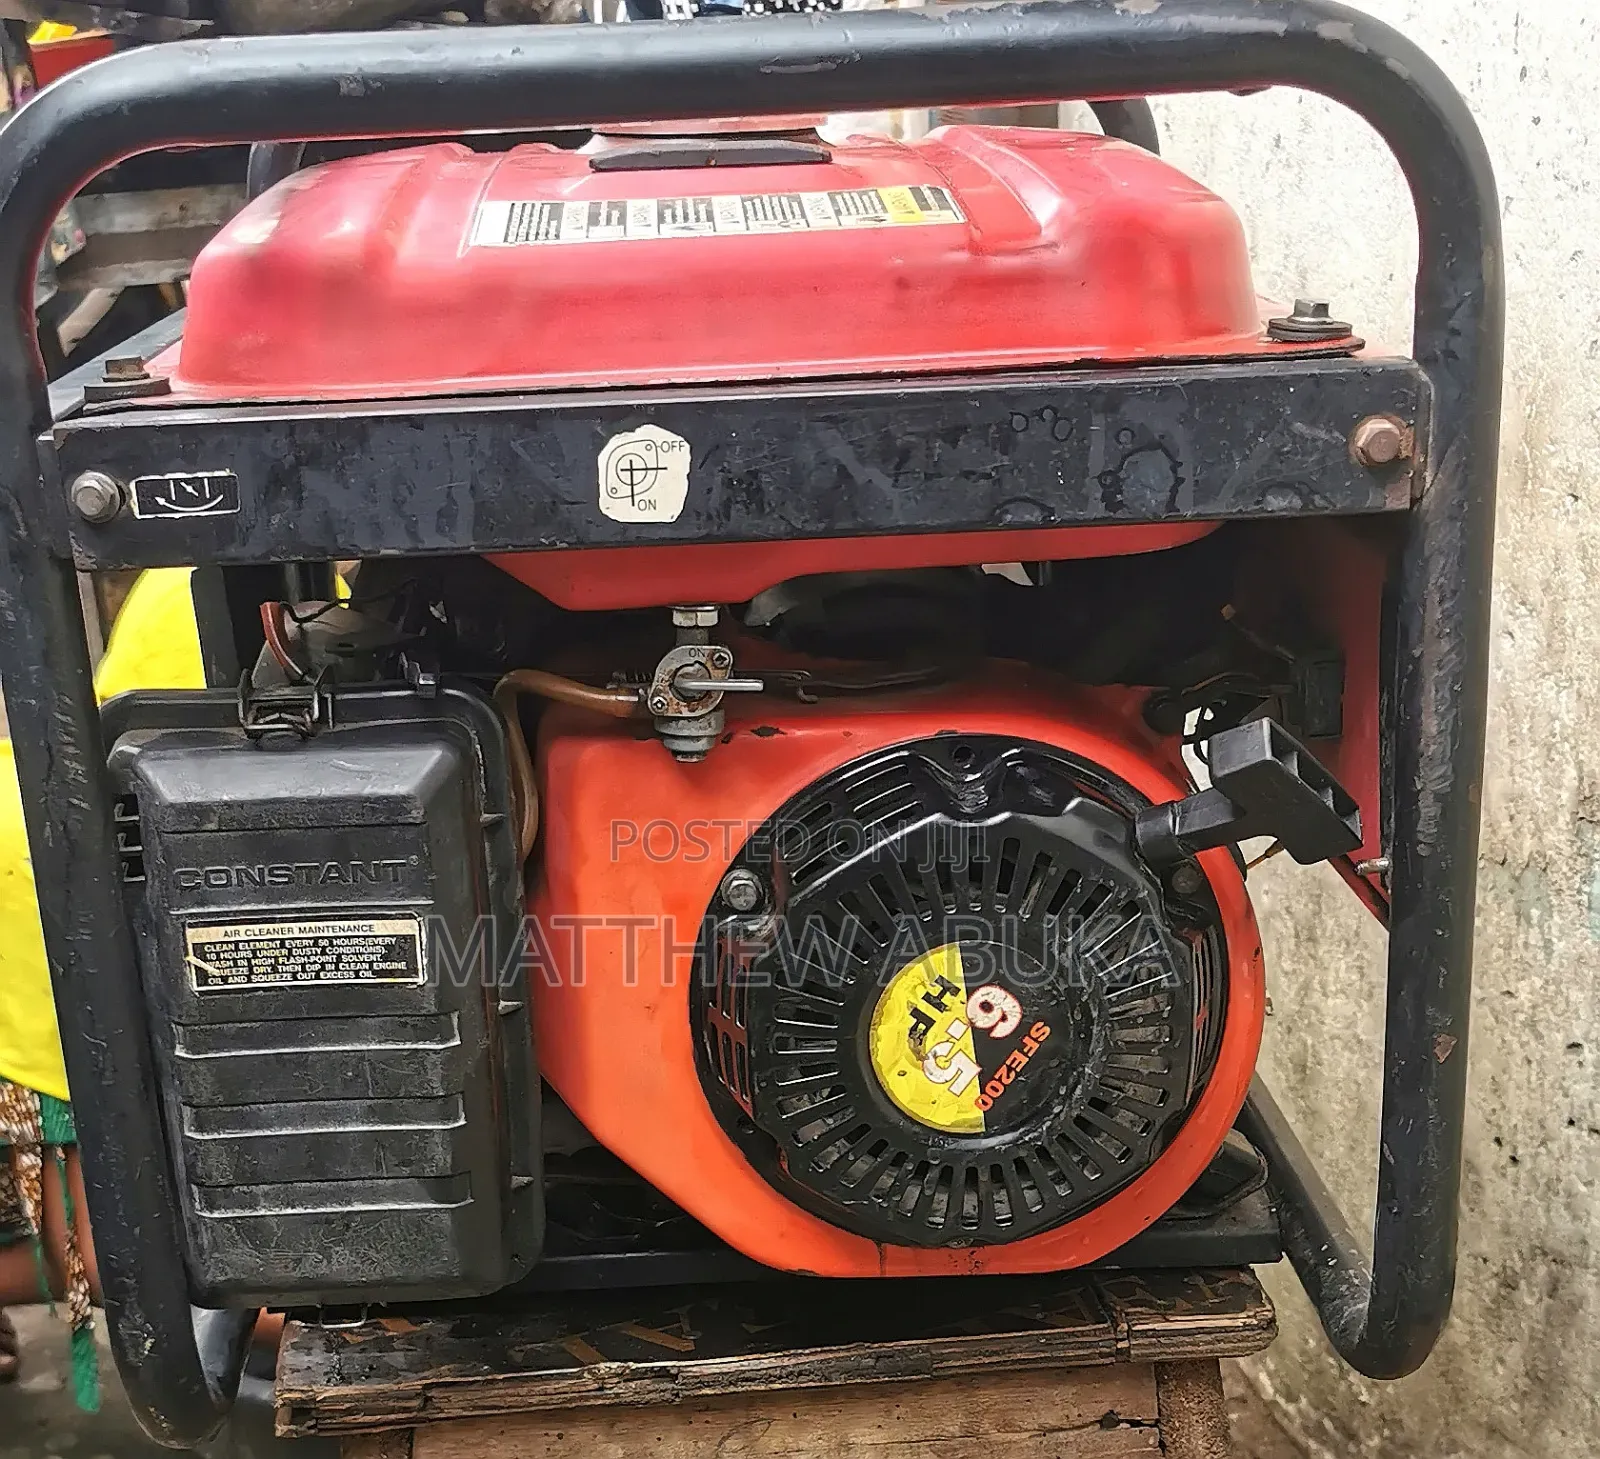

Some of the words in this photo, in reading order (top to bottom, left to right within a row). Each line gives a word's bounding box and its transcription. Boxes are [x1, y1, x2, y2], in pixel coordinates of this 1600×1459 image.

[660, 440, 686, 453] OFF
[637, 499, 657, 511] ON
[688, 647, 706, 657] ON
[223, 929, 241, 938] AIR
[244, 926, 294, 937] CLEANER
[298, 924, 376, 935] MAINTENANCE
[204, 943, 235, 952] CLEAN
[239, 940, 281, 950] ELEMENT
[285, 938, 314, 948] EVERY
[205, 952, 217, 961] 10
[220, 950, 253, 959] HOURS
[256, 948, 289, 958] UNDER
[292, 946, 322, 956] DUSTY
[237, 959, 249, 967] IN
[251, 957, 275, 966] HIGH
[278, 954, 338, 964] FLASH-POINT
[341, 953, 384, 962] SOLVENT.
[277, 964, 302, 973] THEN
[305, 963, 322, 971] DIP
[325, 961, 335, 970] IN
[338, 961, 370, 970] CLEAN
[372, 960, 408, 970] ENGINE
[208, 976, 225, 985] OIL
[227, 974, 249, 984] AND
[250, 972, 294, 982] SQUEEZE
[296, 971, 317, 980] OUT
[319, 970, 356, 979] EXCESS
[974, 1021, 1052, 1112] SFE200
